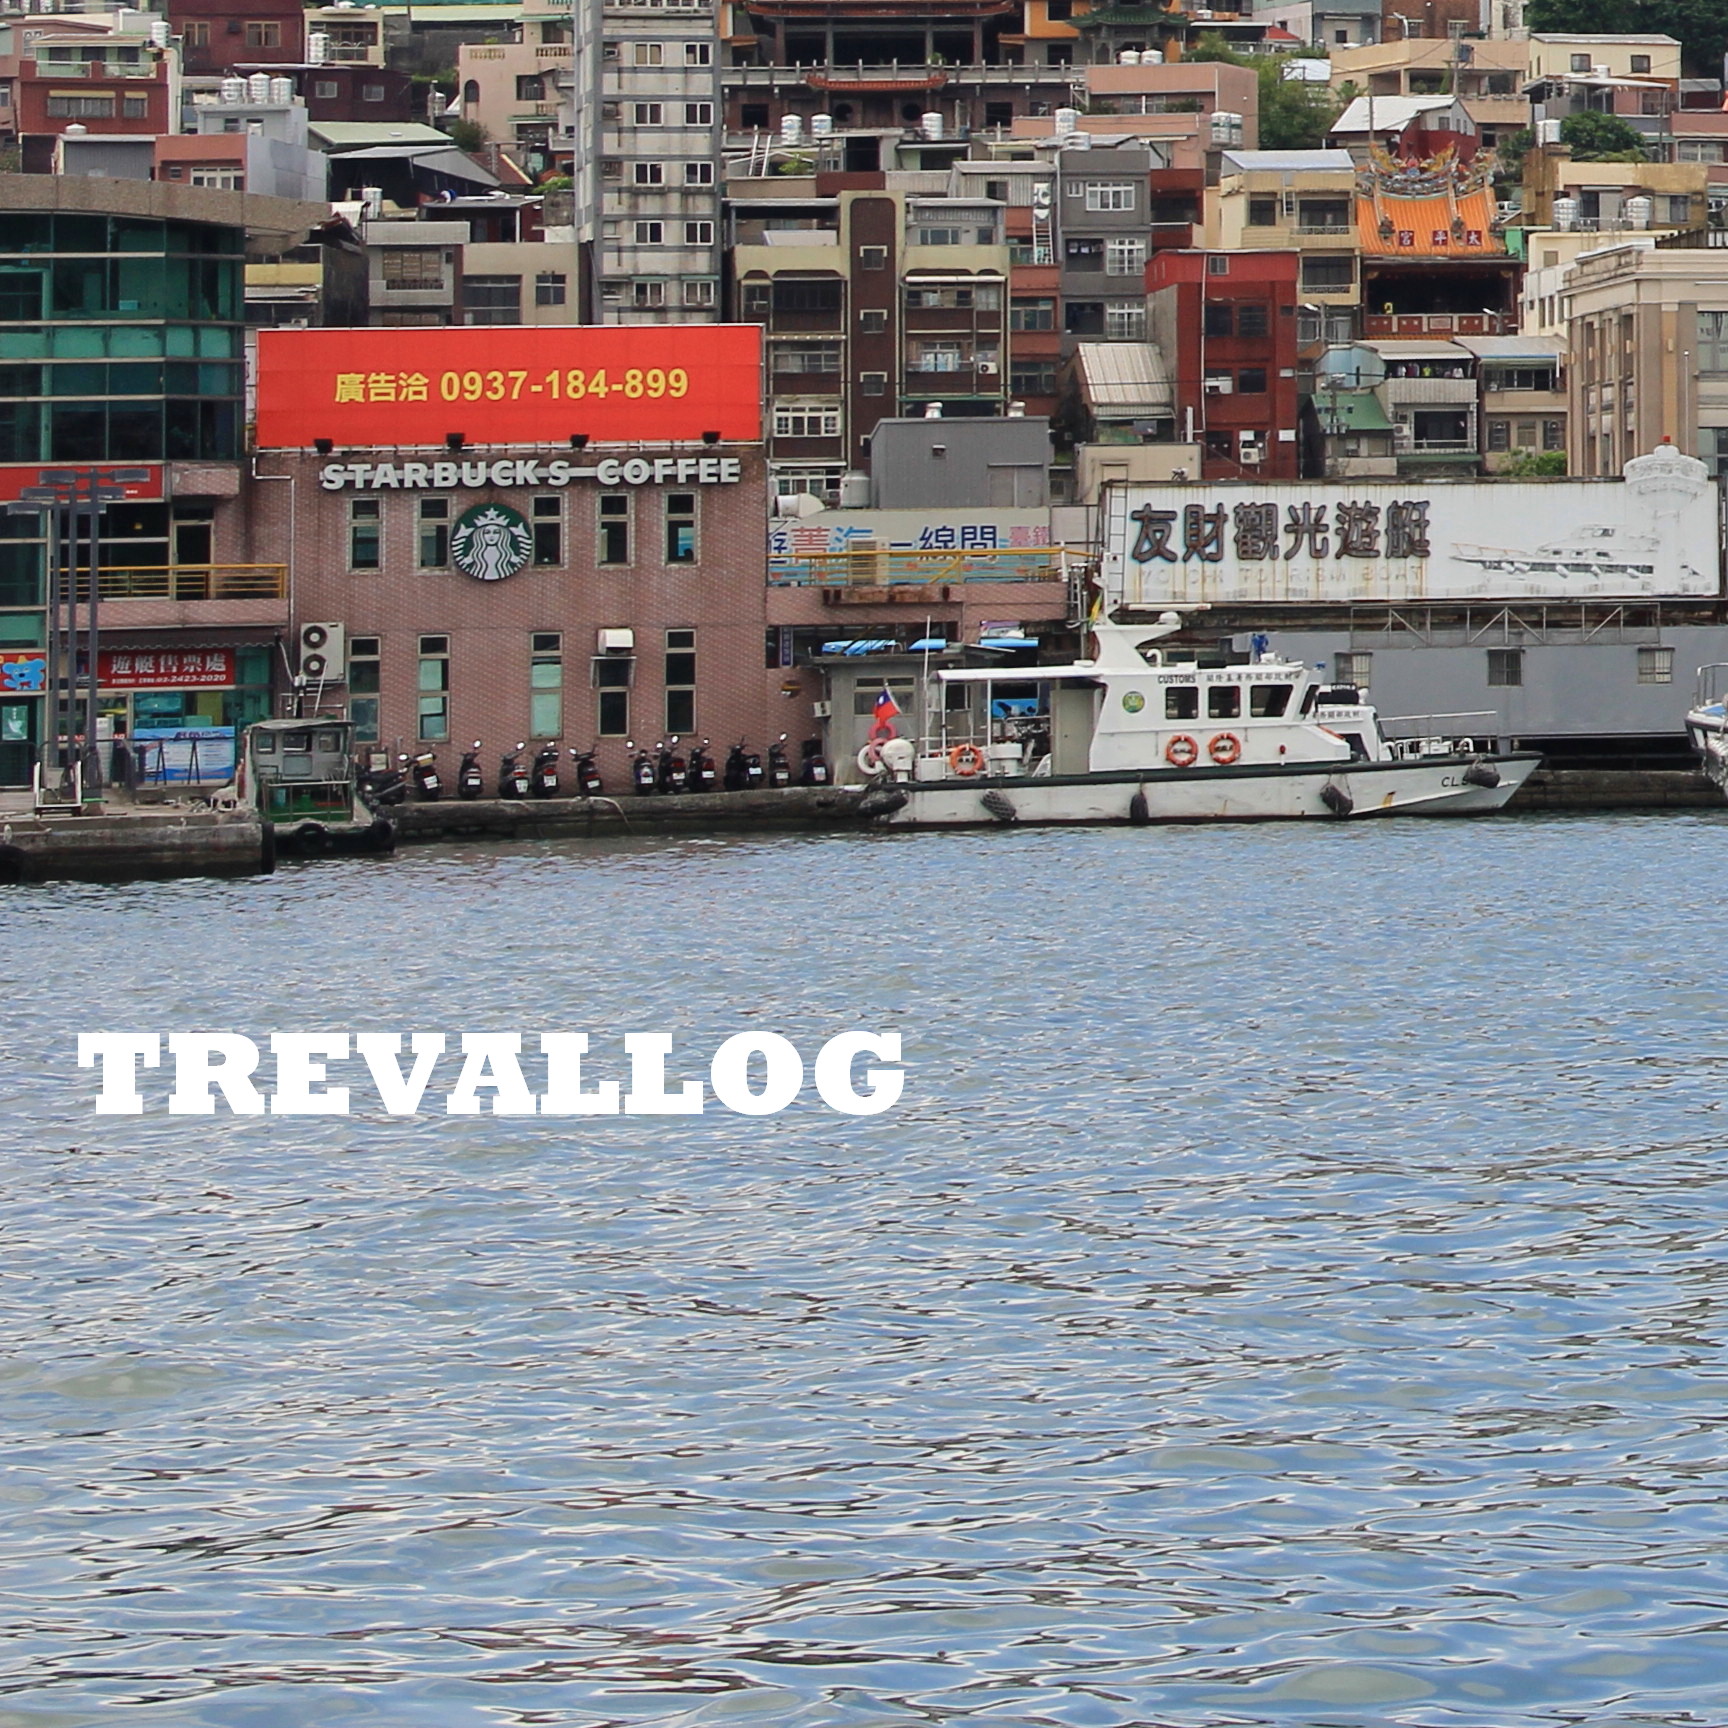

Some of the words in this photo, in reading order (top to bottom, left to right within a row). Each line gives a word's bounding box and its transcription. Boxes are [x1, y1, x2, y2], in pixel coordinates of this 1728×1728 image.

[334, 373, 430, 403] 廣告洽
[440, 368, 690, 402] 0937-184-899
[320, 459, 571, 491] STARBUCKS
[597, 457, 742, 486] COFFEE
[1131, 500, 1432, 563] 友財觀光遊艇
[111, 652, 226, 674] 遊艇售票處
[1158, 674, 1196, 685] CUSTOMS
